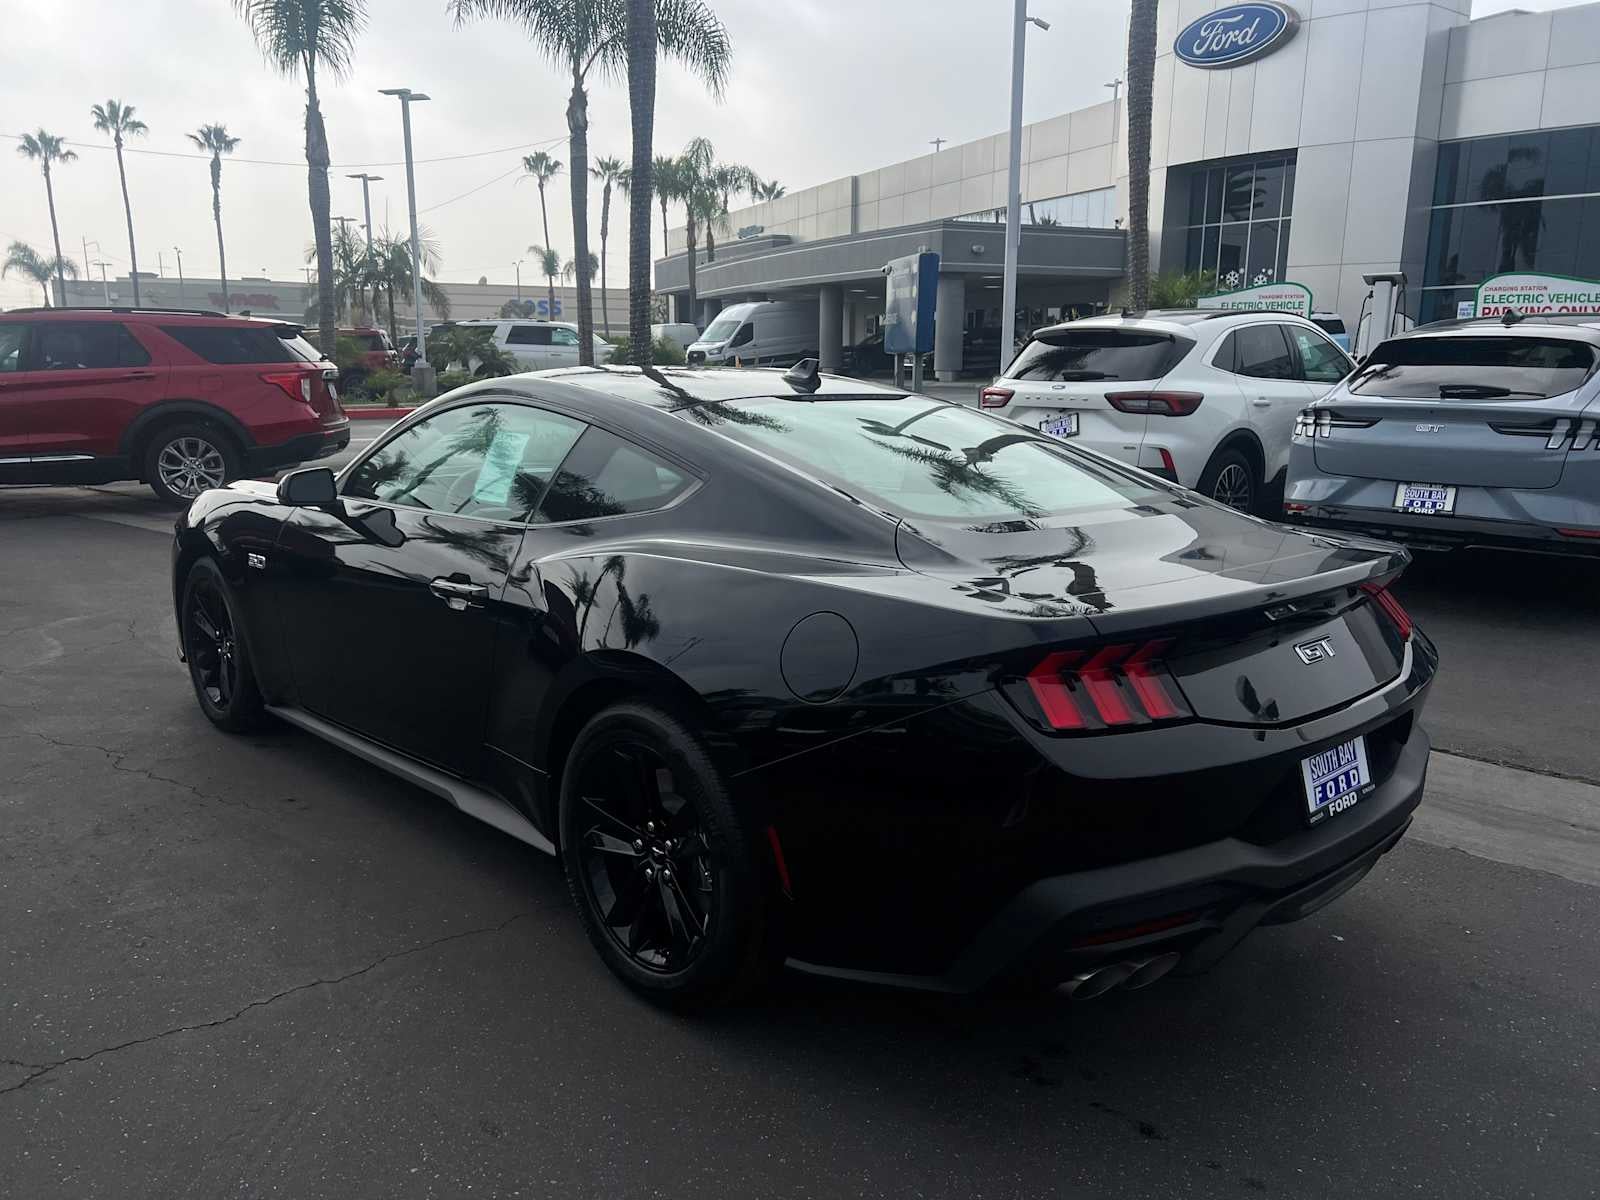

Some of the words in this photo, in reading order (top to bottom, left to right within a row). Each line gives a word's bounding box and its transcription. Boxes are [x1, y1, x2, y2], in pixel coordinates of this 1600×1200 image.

[1193, 14, 1260, 55] Ford
[509, 299, 561, 316] OSS
[1221, 302, 1263, 311] ELECTRIC
[1265, 301, 1304, 310] VEHICLE
[1483, 294, 1544, 304] ELECTRIC
[1548, 293, 1600, 303] VEHICLE
[1404, 500, 1444, 510] FORD
[1405, 489, 1430, 499] SOUTH
[1431, 491, 1447, 500] BAY
[1294, 635, 1336, 665] GT
[1310, 748, 1338, 780] SOUTH
[1338, 739, 1357, 767] BAY
[1315, 768, 1359, 805] FORD
[1328, 791, 1358, 817] FORD
